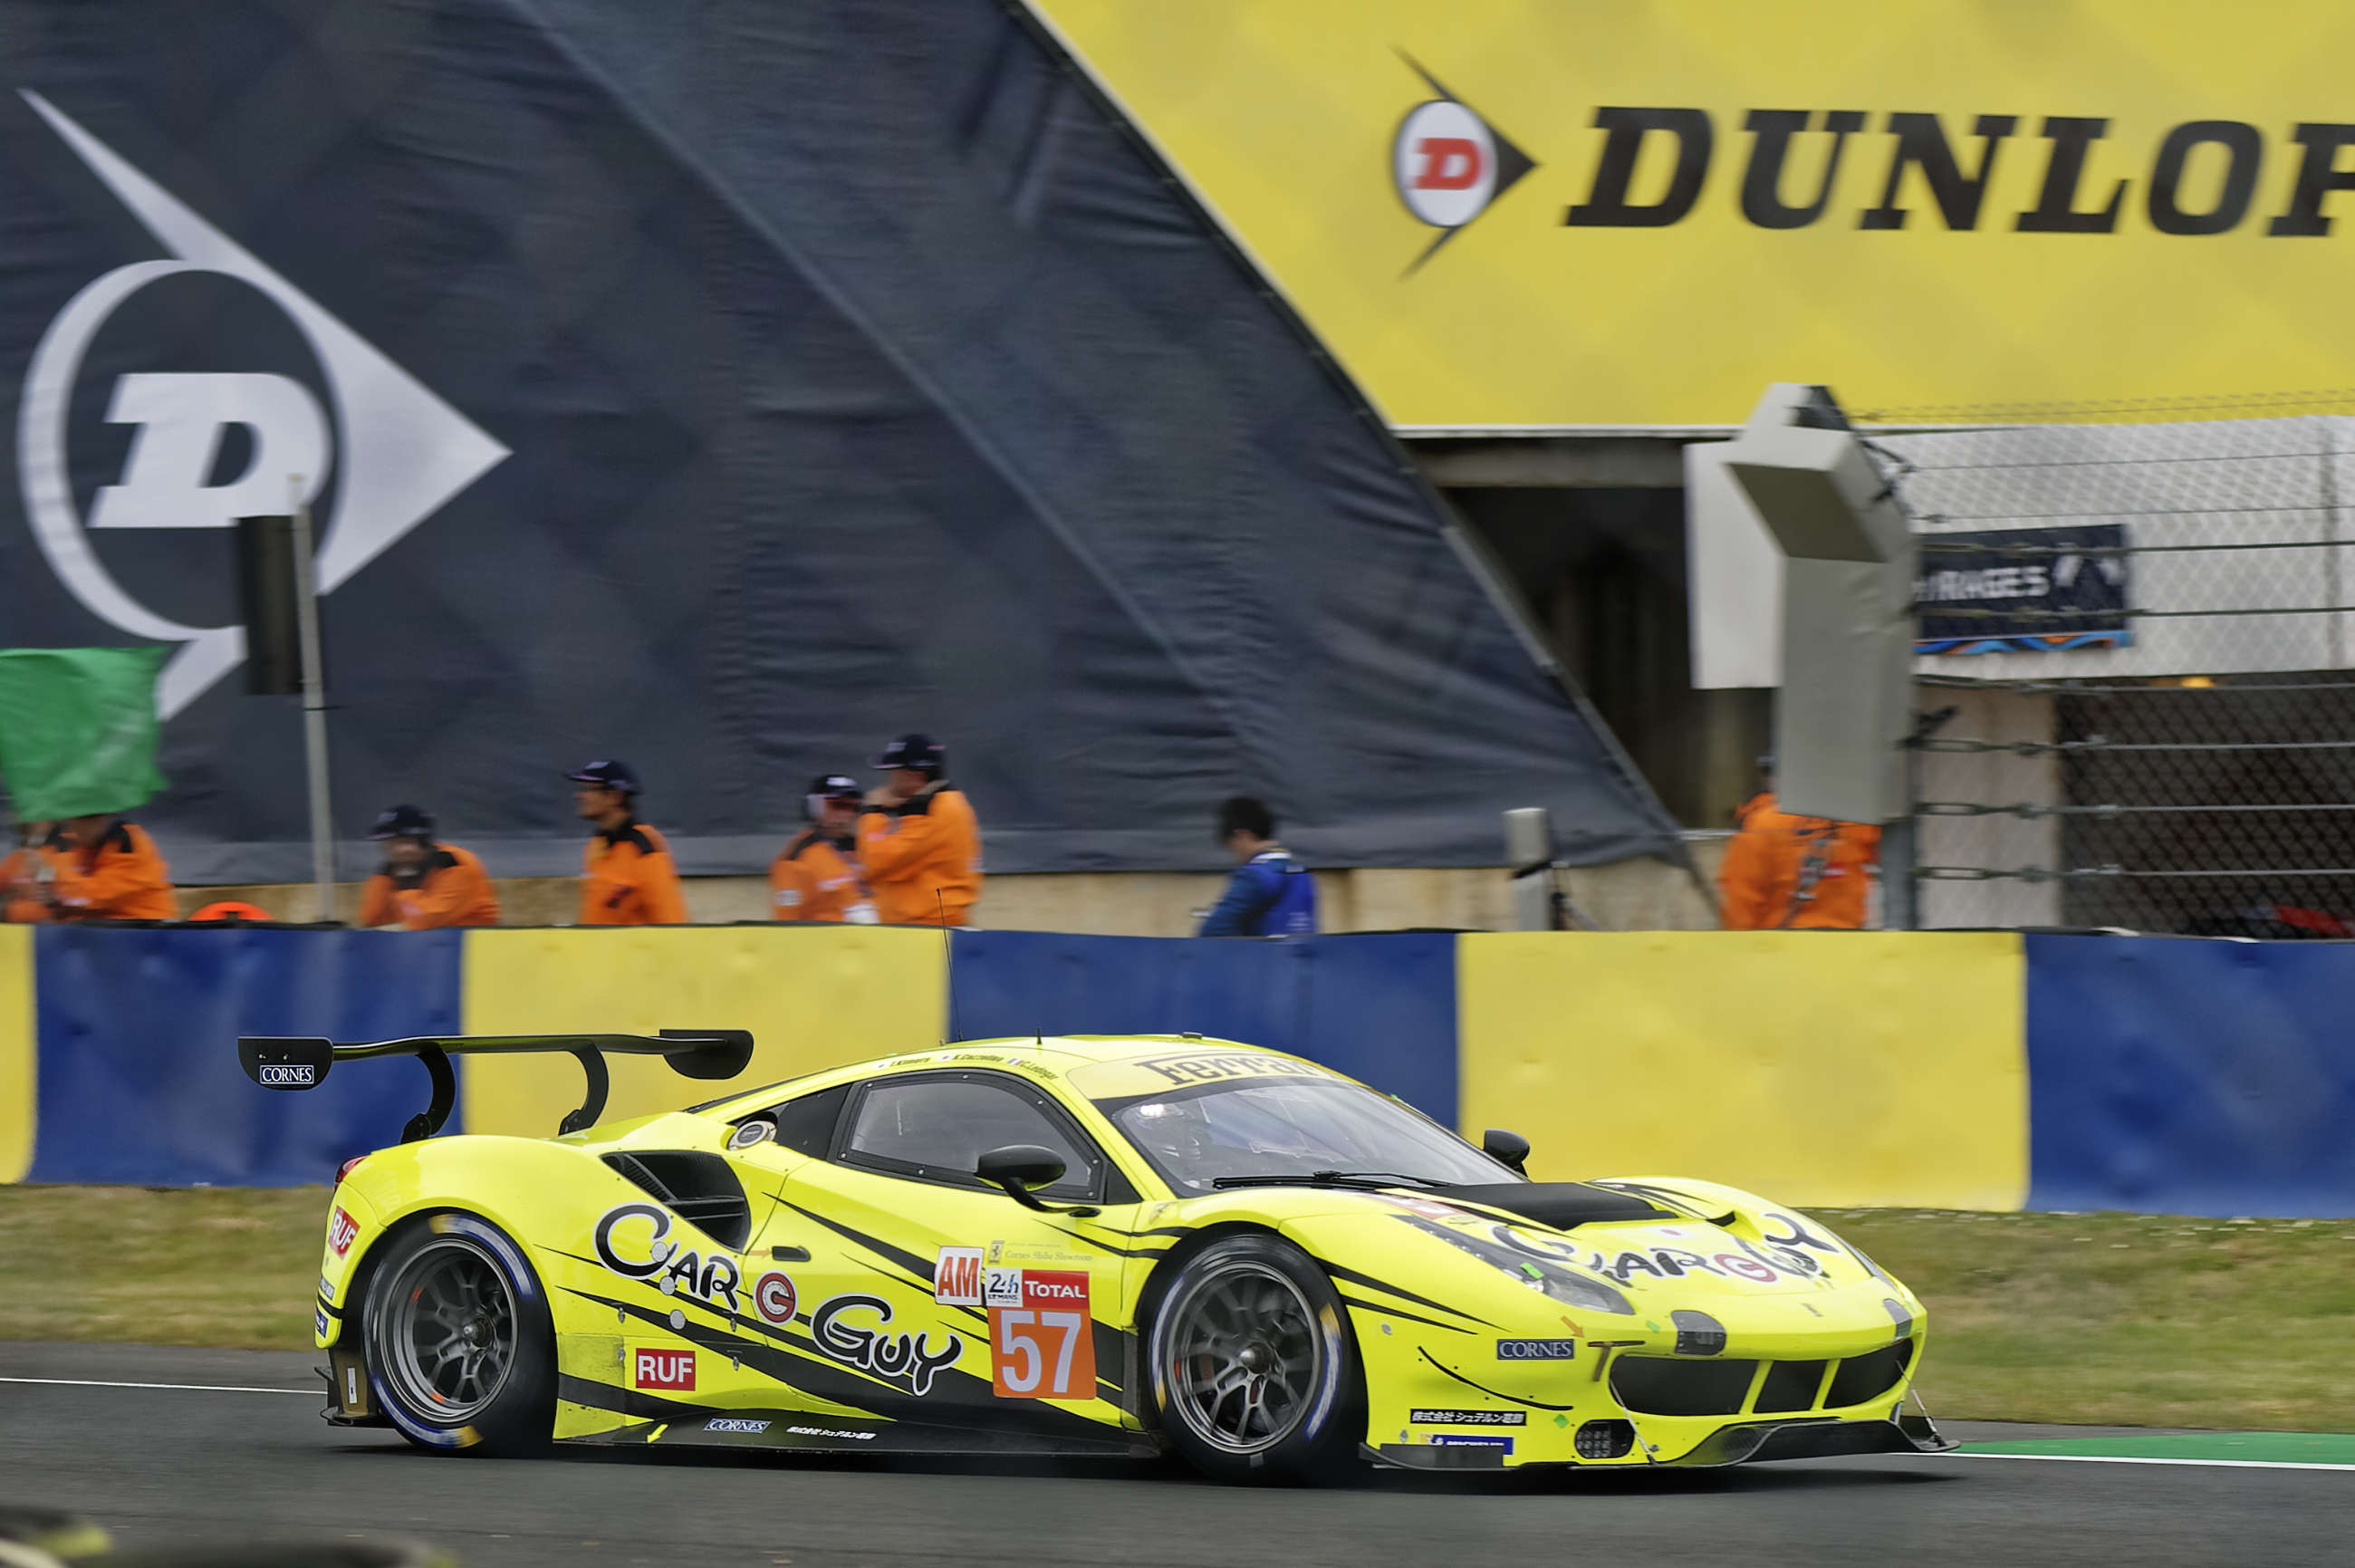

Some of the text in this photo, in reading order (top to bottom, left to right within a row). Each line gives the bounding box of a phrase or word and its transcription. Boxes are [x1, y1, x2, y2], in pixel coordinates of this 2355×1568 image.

[1415, 138, 1483, 191] D
[86, 372, 333, 529] D
[262, 1067, 312, 1082] CORNES
[330, 1212, 357, 1250] RUF
[937, 1256, 980, 1297] AM
[594, 1202, 963, 1396] CAR GUY
[638, 1354, 694, 1383] RUF
[1000, 1310, 1081, 1393] 57
[1499, 1342, 1572, 1358] CORNES
[710, 1419, 767, 1432] CORNES
